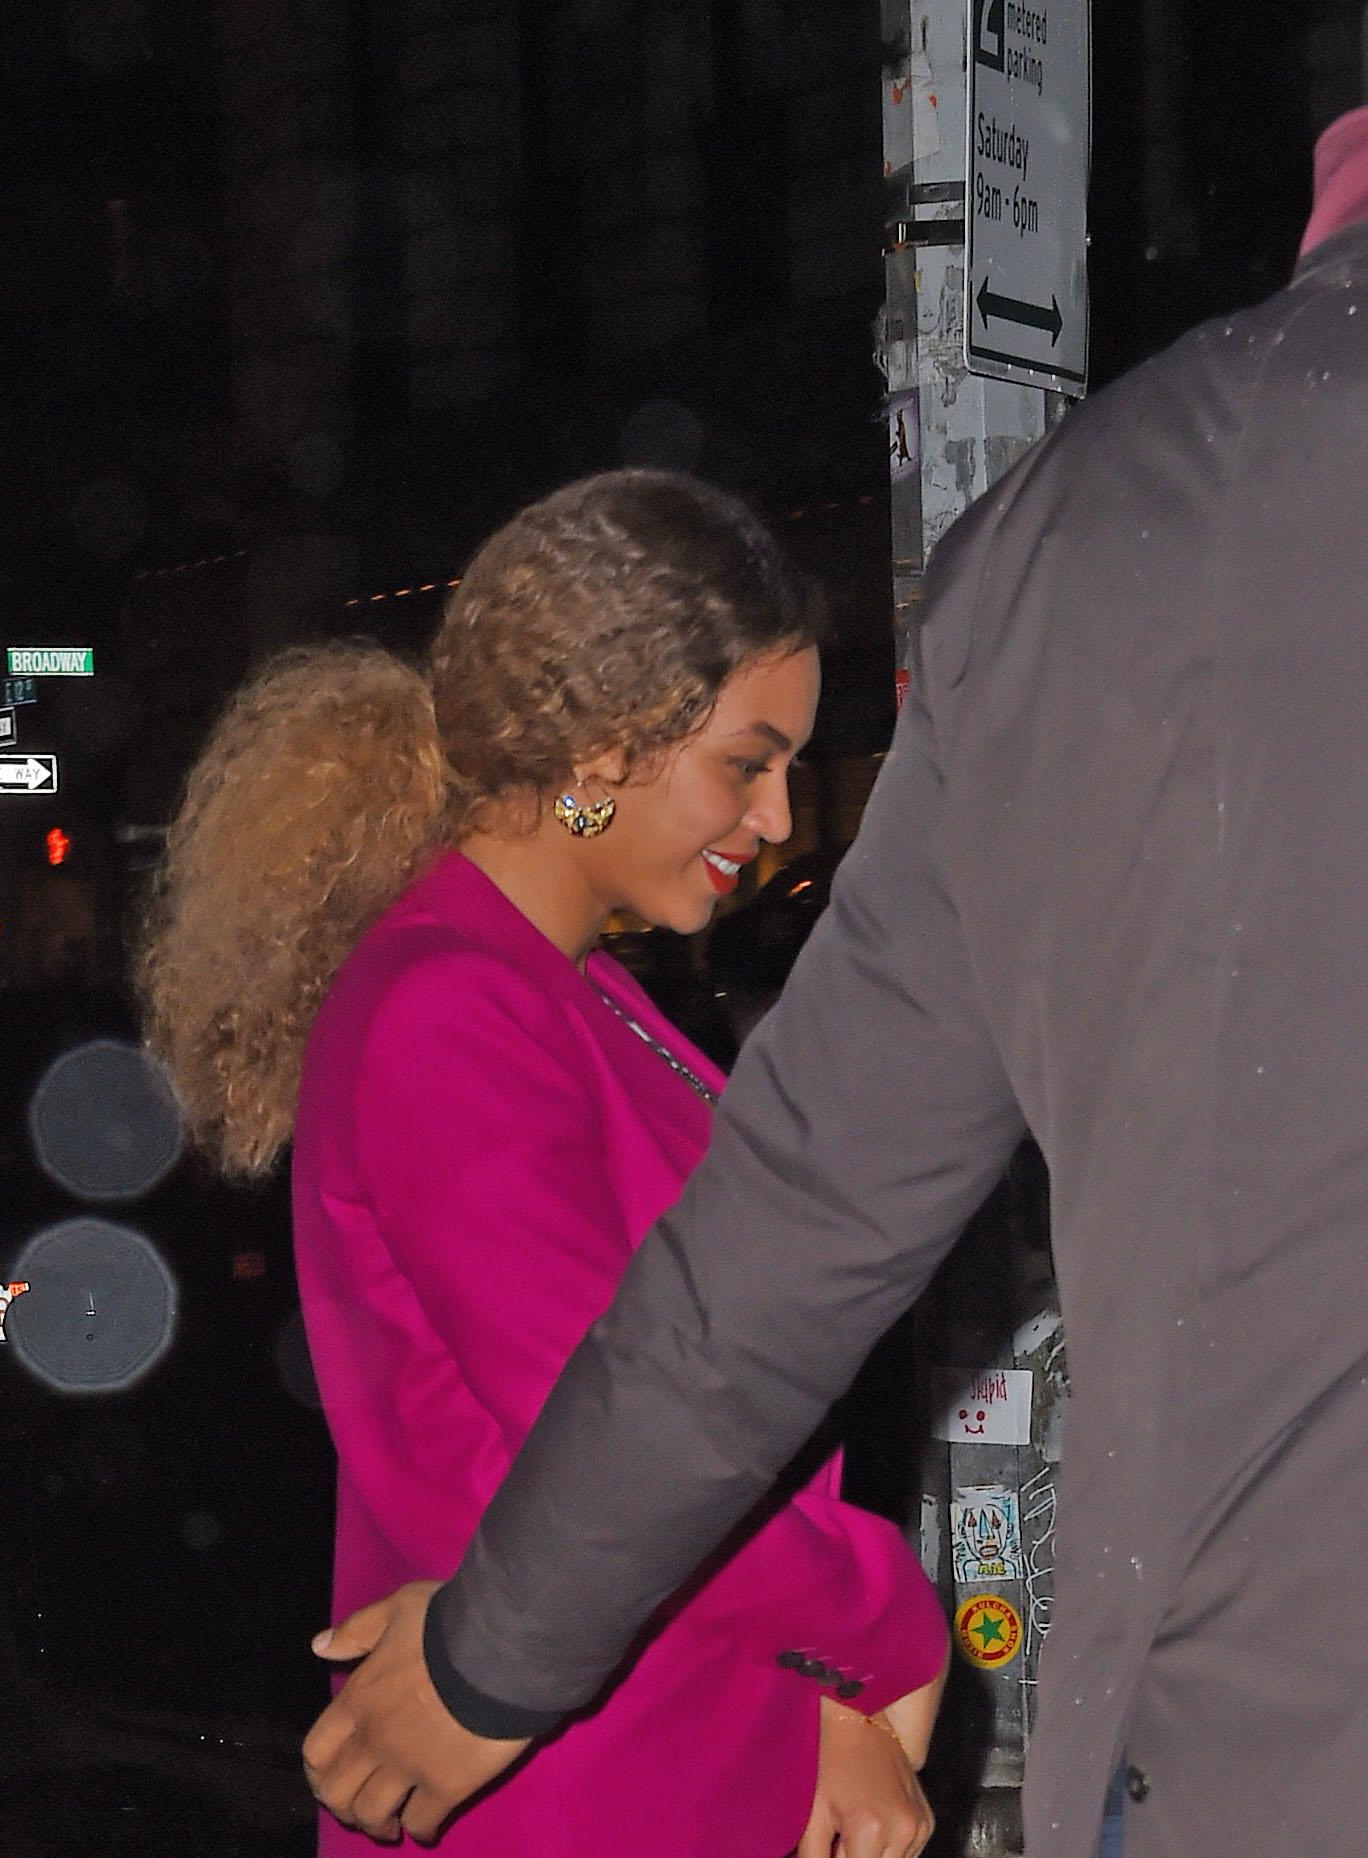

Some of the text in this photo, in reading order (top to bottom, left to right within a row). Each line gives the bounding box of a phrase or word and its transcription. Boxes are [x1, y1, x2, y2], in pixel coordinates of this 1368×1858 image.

[1007, 0, 1047, 45] metered
[1007, 46, 1043, 96] parking
[977, 112, 1029, 181] Saturday
[976, 172, 1002, 221] 9am
[1013, 185, 1038, 239] 6pm
[12, 651, 87, 672] BROADWAY
[15, 767, 41, 780] WAY
